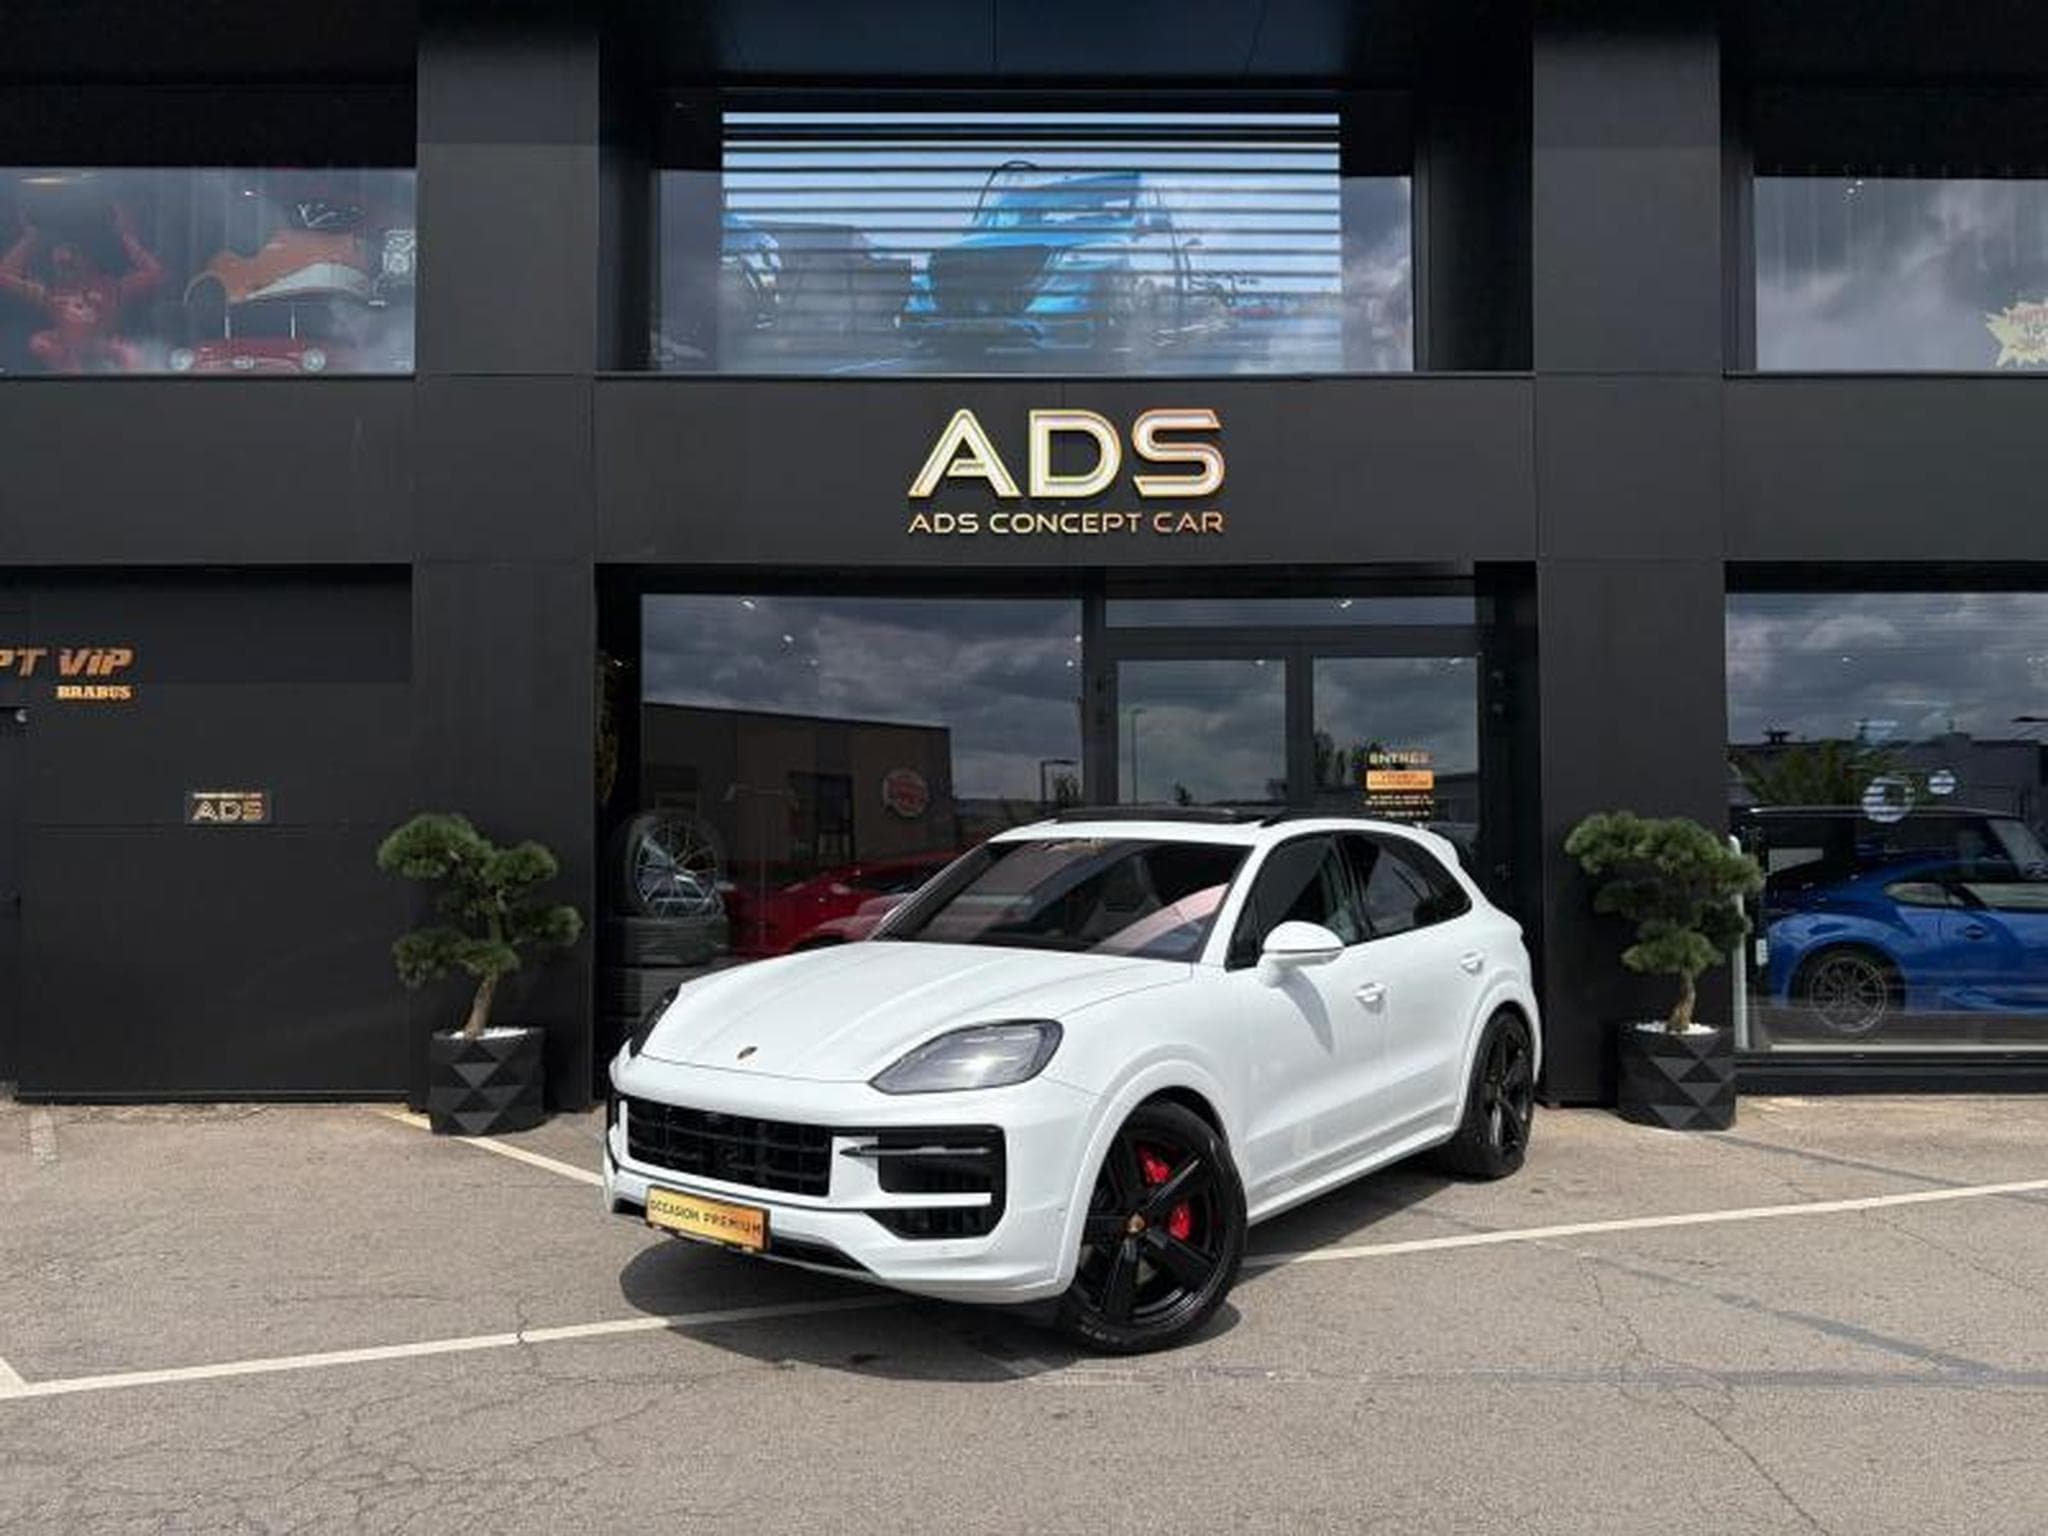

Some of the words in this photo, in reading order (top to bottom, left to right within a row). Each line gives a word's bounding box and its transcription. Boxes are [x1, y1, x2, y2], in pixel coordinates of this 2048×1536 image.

[907, 409, 1225, 498] ADS
[908, 513, 979, 534] ADS
[990, 513, 1142, 534] CONCEPT
[1153, 511, 1225, 533] CAR
[56, 685, 131, 699] BRABUS
[192, 801, 264, 821] ADS
[650, 1199, 701, 1223] OCCASION
[703, 1212, 761, 1235] PREMIUM
